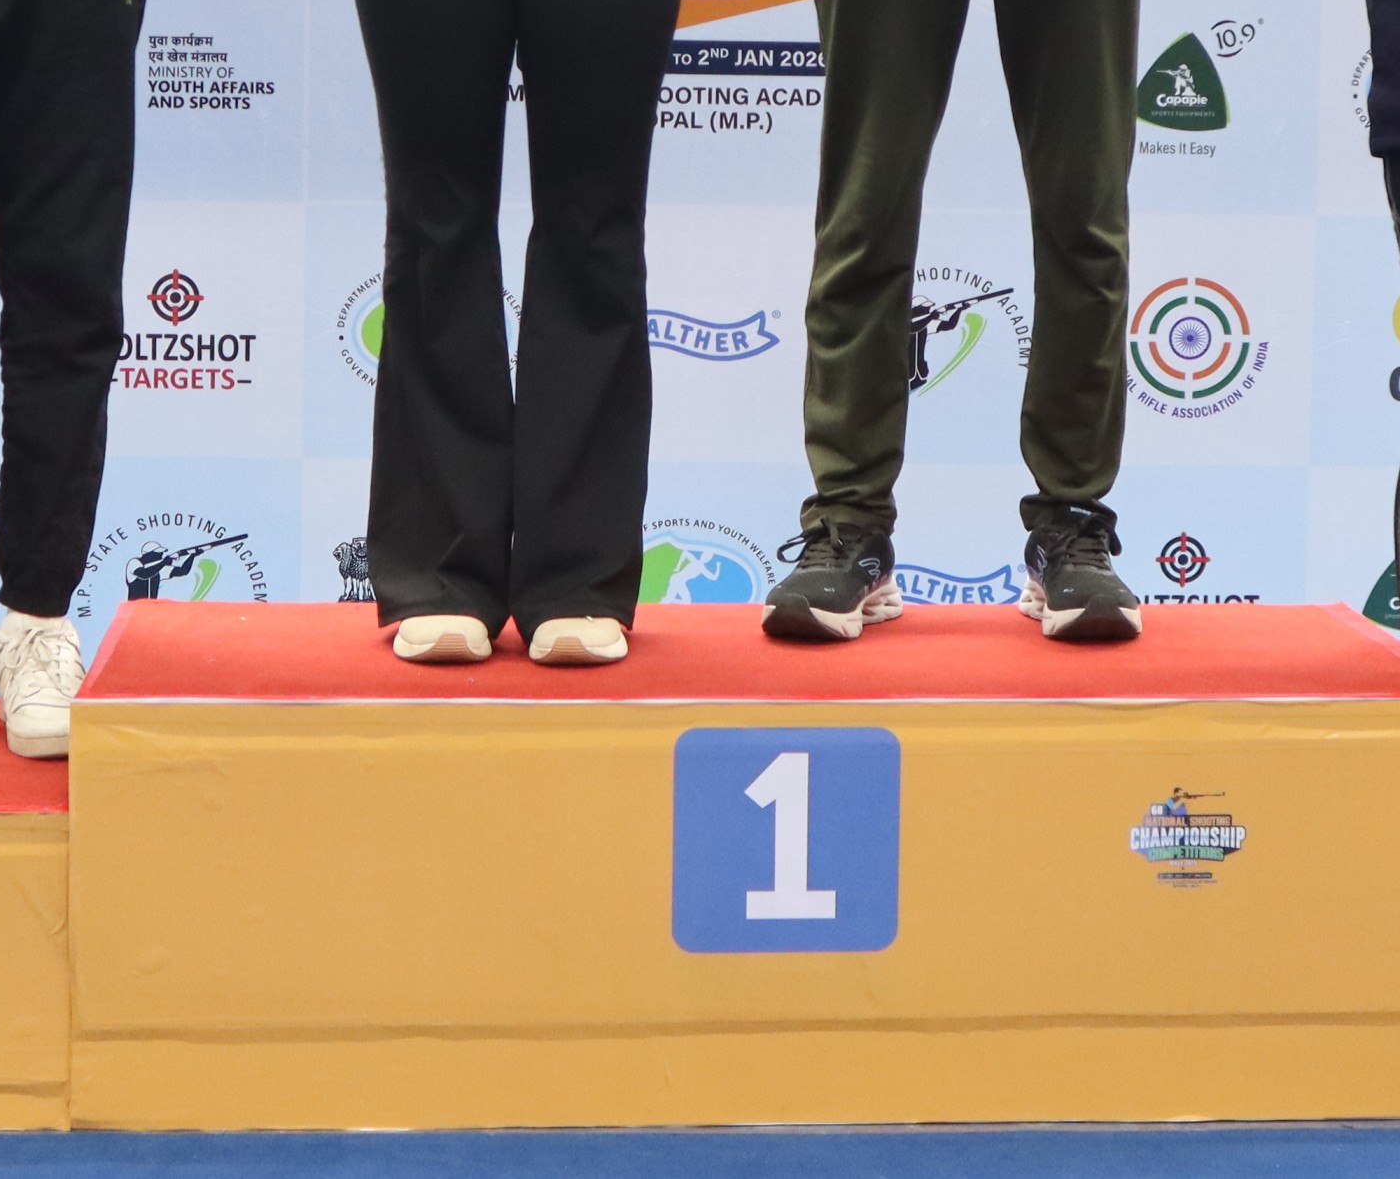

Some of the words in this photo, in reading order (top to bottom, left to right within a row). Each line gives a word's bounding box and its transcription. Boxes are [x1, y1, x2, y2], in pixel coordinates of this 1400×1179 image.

[172, 33, 213, 46] कार्यक्रम
[1216, 23, 1255, 51] 10.9
[168, 49, 187, 62] खेल
[673, 53, 692, 65] TO
[735, 50, 774, 66] JAN
[149, 67, 213, 78] MINISTRY
[217, 67, 234, 78] OF
[148, 81, 204, 93] YOUTH
[210, 82, 274, 94] AFFAIRS
[148, 96, 184, 109] AND
[189, 97, 250, 109] SPORTS
[1156, 93, 1208, 107] Capapie
[710, 111, 773, 133] (M.P.)
[1139, 142, 1176, 155] Makes
[1179, 142, 1187, 155] It
[1190, 142, 1216, 157] Easy
[917, 267, 993, 293] HOOTING
[997, 295, 1032, 369] ACADEMY
[121, 368, 234, 390] TARGETS
[1138, 391, 1166, 414] RIFLE
[1172, 390, 1243, 418] ASSOCIATION
[1243, 374, 1256, 390] OF
[1253, 341, 1269, 371] INDIA
[85, 528, 128, 572] STATE
[138, 513, 227, 540] SHOOTING
[651, 518, 690, 531] SPORTS
[694, 519, 715, 529] AND
[719, 524, 749, 546] YOUTH
[750, 543, 776, 585] WELFARE
[744, 751, 837, 920] 1
[1130, 827, 1245, 850] CHAMPIONSHIP
